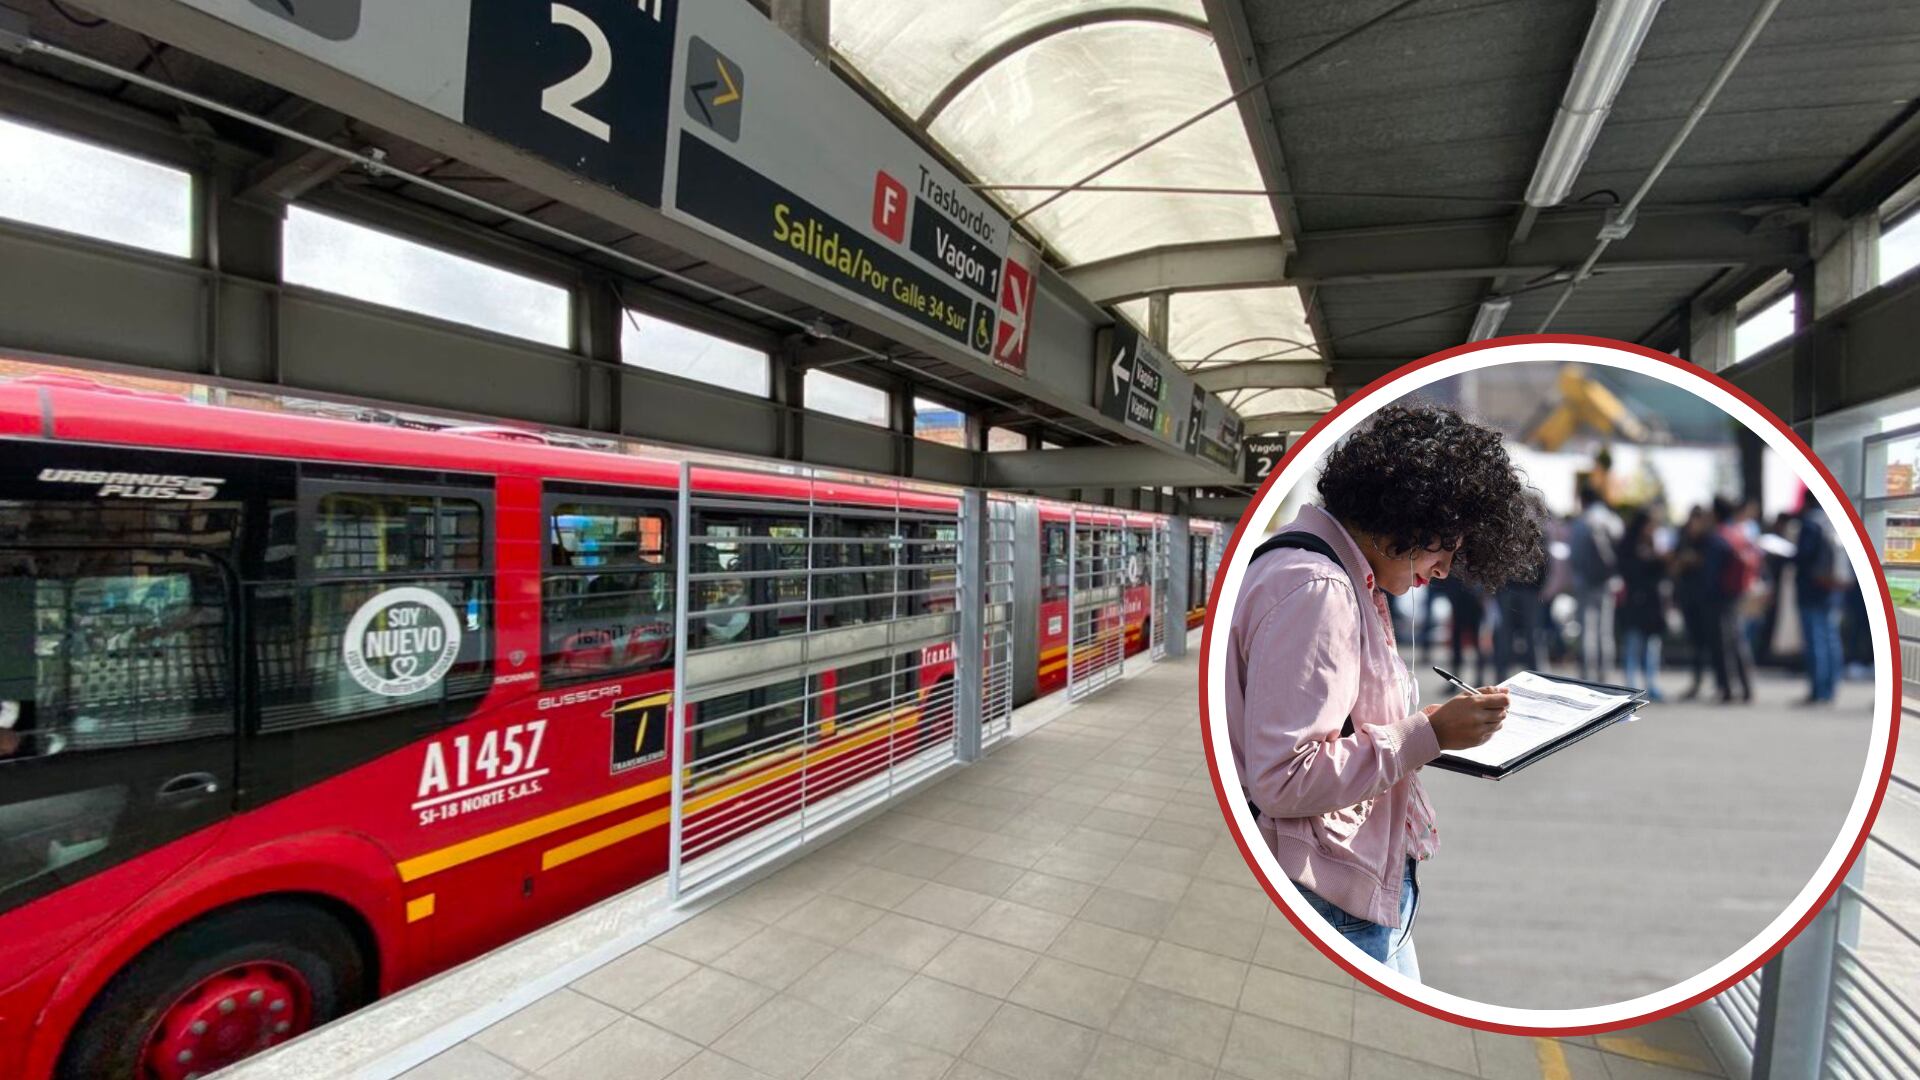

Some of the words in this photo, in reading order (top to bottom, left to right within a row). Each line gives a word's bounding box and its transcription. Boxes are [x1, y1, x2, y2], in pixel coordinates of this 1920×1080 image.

[541, 2, 612, 143] 2
[882, 185, 898, 225] F
[918, 164, 995, 244] Trasbordo:
[936, 227, 985, 285] Vagón
[991, 268, 998, 294] 1
[892, 277, 926, 311] Calle
[928, 296, 944, 322] 34
[946, 306, 966, 332] Sur
[1136, 361, 1154, 390] Vagón
[1249, 443, 1283, 454] Vagón
[1257, 457, 1271, 477] 2
[388, 607, 420, 627] SOY
[366, 626, 442, 658] NUEVO
[538, 685, 622, 710] BUSSCAR
[418, 719, 548, 797] A1457
[420, 803, 458, 825] SI-18
[461, 789, 505, 814] NORTE
[507, 779, 542, 800] S.A.S.
